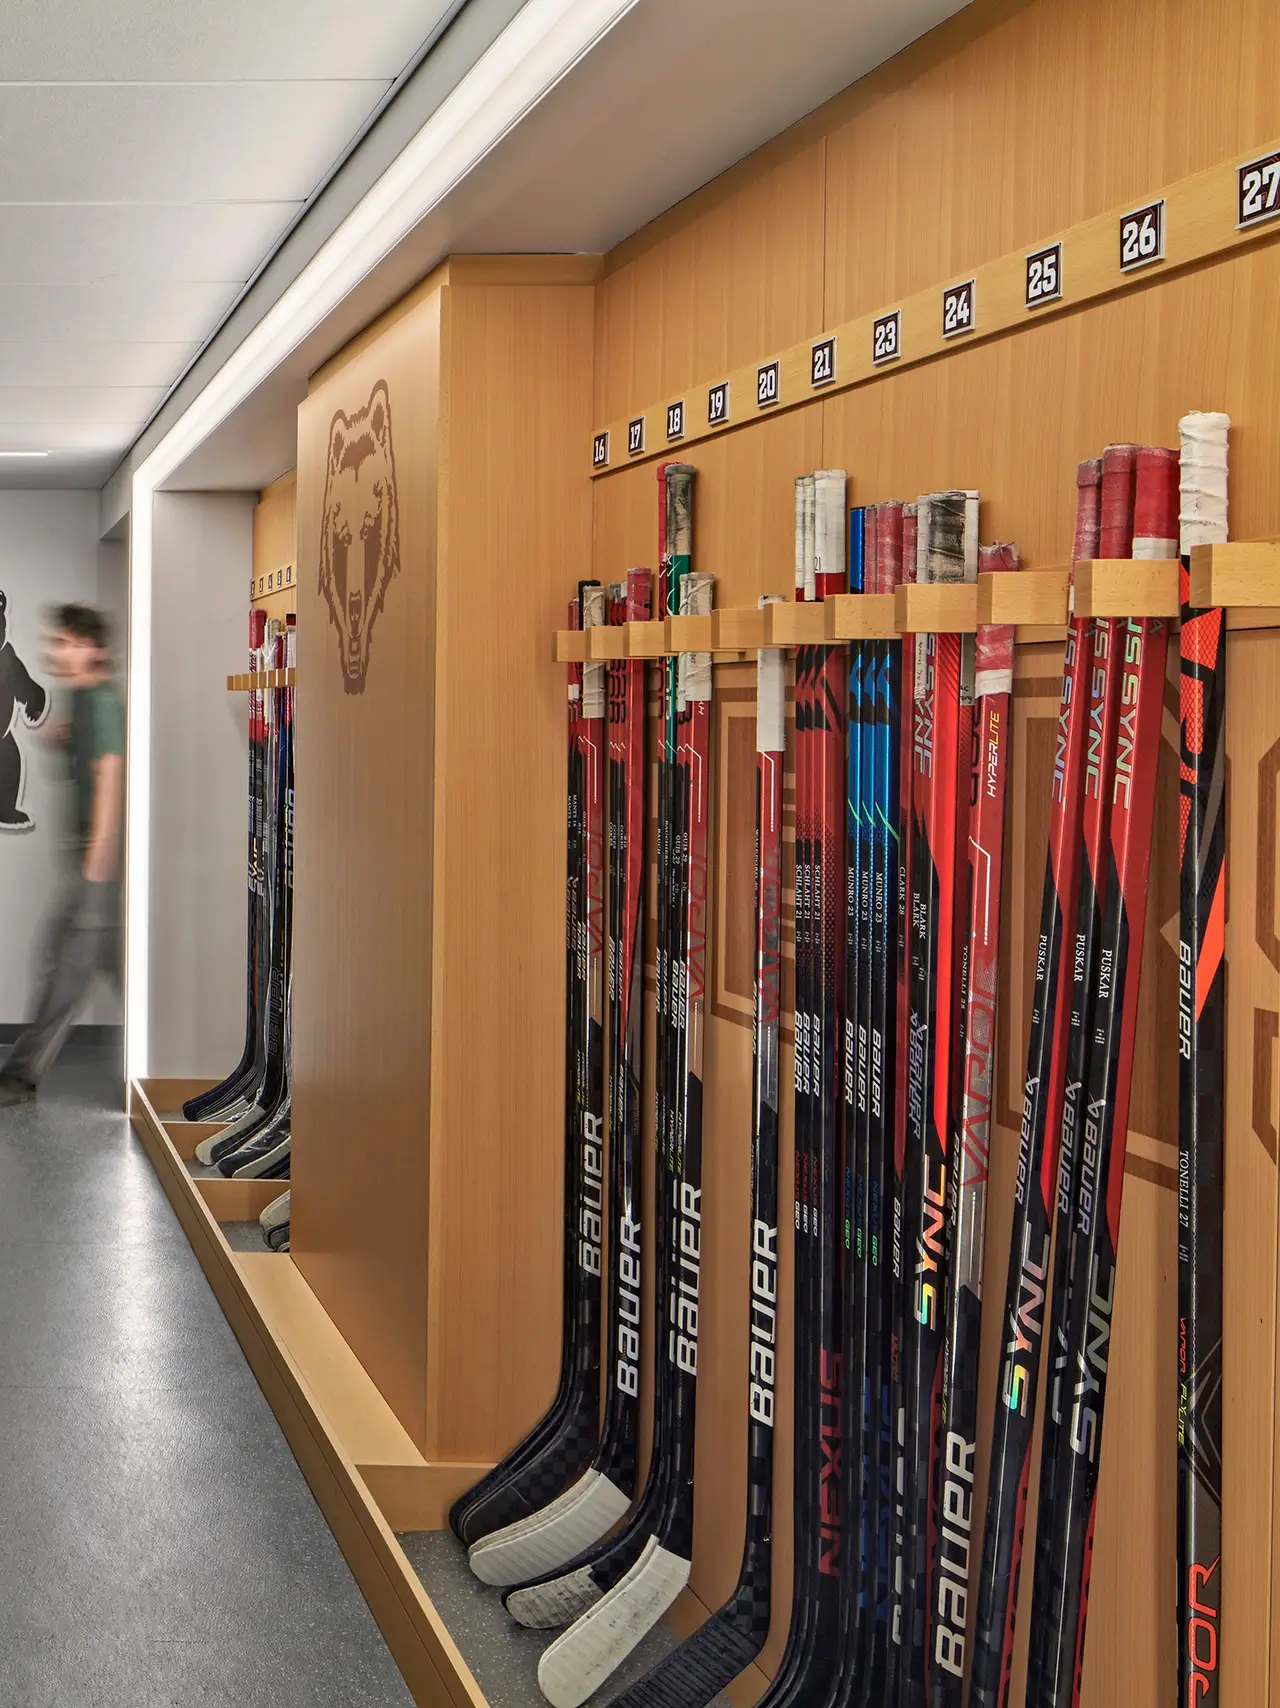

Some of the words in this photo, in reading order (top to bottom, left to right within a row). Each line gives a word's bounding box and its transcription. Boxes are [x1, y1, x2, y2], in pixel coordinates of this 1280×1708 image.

[1243, 161, 1280, 217] 27
[1028, 255, 1056, 298] 25
[1123, 214, 1156, 262] 26
[875, 319, 896, 356] 23
[945, 290, 969, 330] 24
[710, 390, 723, 419] 19
[758, 369, 776, 400] 20
[814, 346, 831, 379] 21
[593, 441, 604, 462] 16
[630, 424, 641, 449] 17
[668, 409, 681, 434] 18
[922, 664, 936, 779] SYNC
[987, 711, 1001, 798] HYPERLITE
[1052, 675, 1073, 803] SYNC
[1085, 666, 1106, 800] SYNC
[1113, 672, 1139, 809] SYNC
[1036, 934, 1047, 980] PUSKAR
[1074, 933, 1086, 982] PUSKAR
[1098, 948, 1112, 998] PUSKAR
[1179, 939, 1192, 1060] BAUER
[794, 1010, 803, 1093] BAUER
[802, 1012, 811, 1095] BAUER
[845, 1018, 854, 1105] BAUER
[858, 1025, 867, 1112] BAUER
[872, 1028, 881, 1118] BAUER
[951, 1132, 960, 1226] BAUER
[1014, 1092, 1033, 1205] BAUER
[1058, 1103, 1075, 1215] BAUER
[1077, 1119, 1098, 1236] BAUER
[1179, 1150, 1189, 1210] TONELLI
[582, 1111, 603, 1277] BAUER
[1179, 1212, 1189, 1228] 27
[676, 1182, 702, 1376] BAUER
[893, 1197, 902, 1279] BAUER
[914, 1153, 946, 1331] SYNC
[617, 1216, 641, 1398] BAUER
[749, 1219, 778, 1427] BAUER
[1003, 1220, 1050, 1418] SYNC
[1178, 1317, 1187, 1374] VAPOR
[1070, 1253, 1116, 1463] SYNC
[1177, 1382, 1188, 1446] FLYLITE
[819, 1348, 844, 1577] NEXUS
[935, 1431, 976, 1678] BAUER
